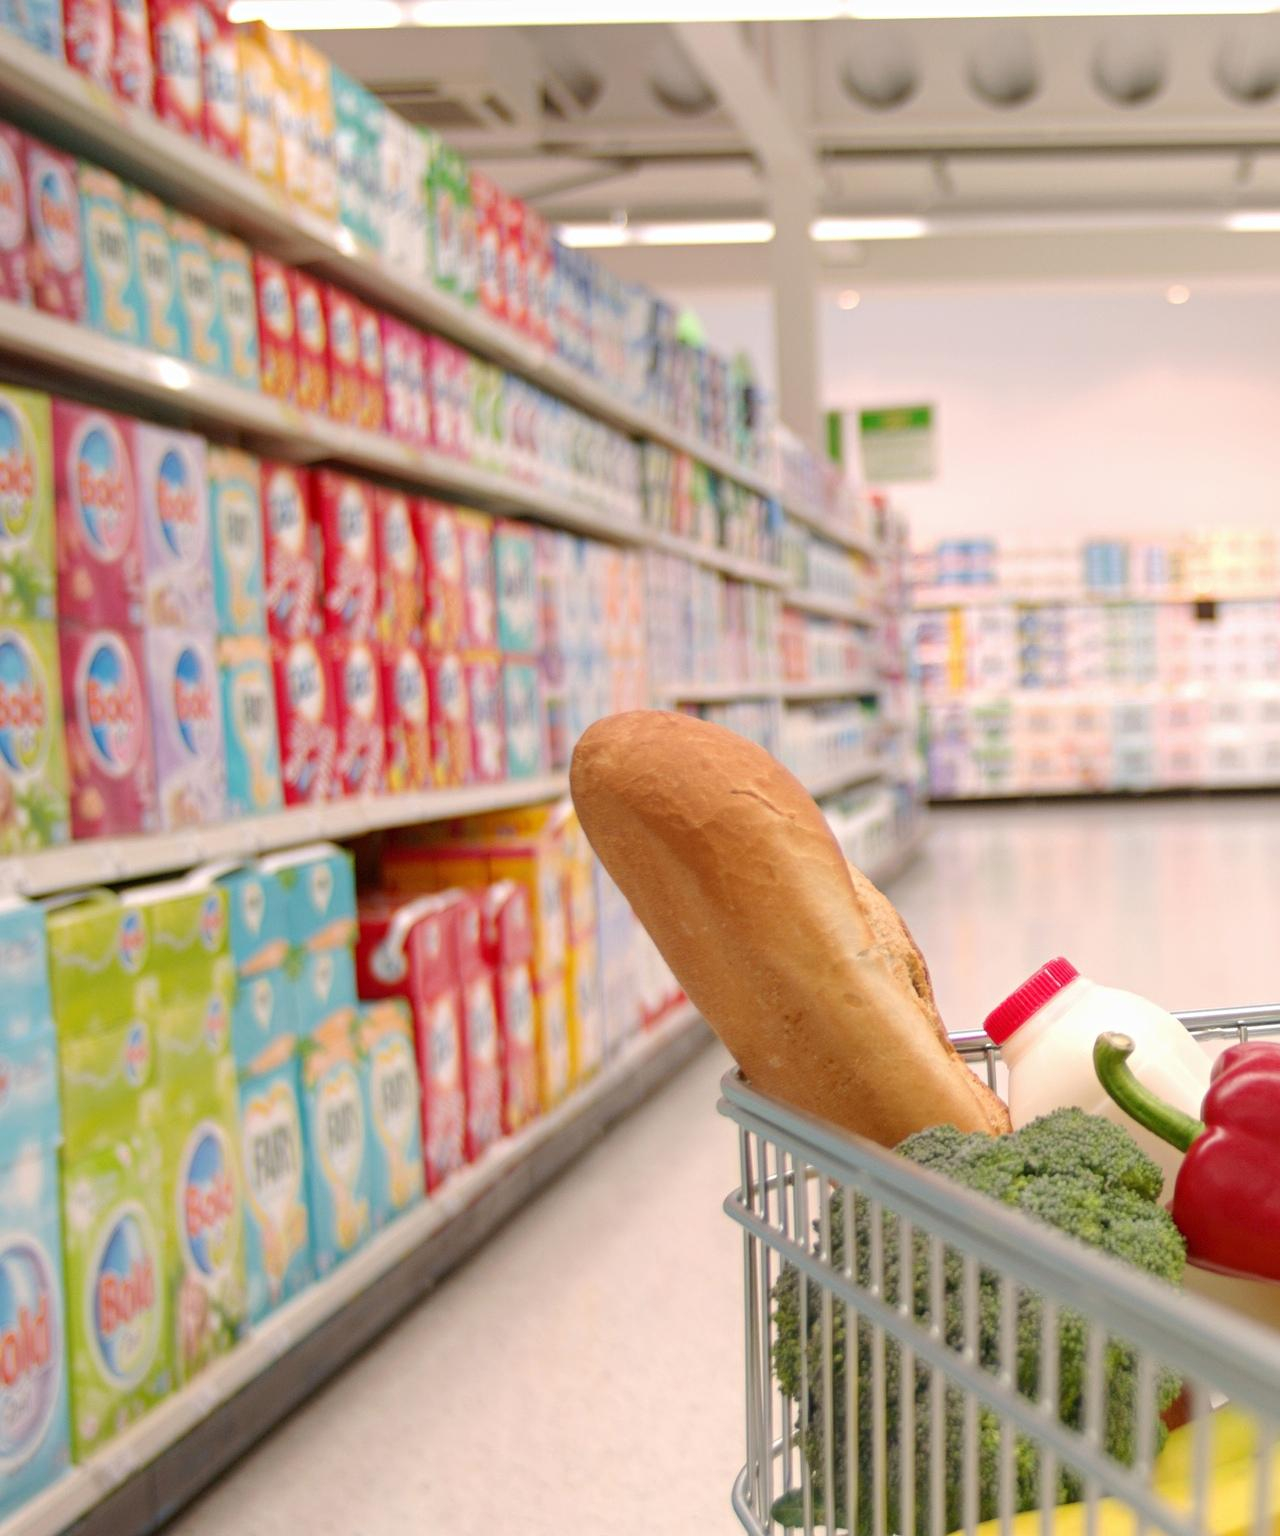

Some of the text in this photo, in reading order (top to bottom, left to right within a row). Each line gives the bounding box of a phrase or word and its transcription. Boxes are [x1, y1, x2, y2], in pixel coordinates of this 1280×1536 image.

[0, 453, 34, 498] old
[187, 1171, 234, 1238] Bold
[101, 1254, 154, 1336] Bold
[0, 1296, 51, 1385] old
